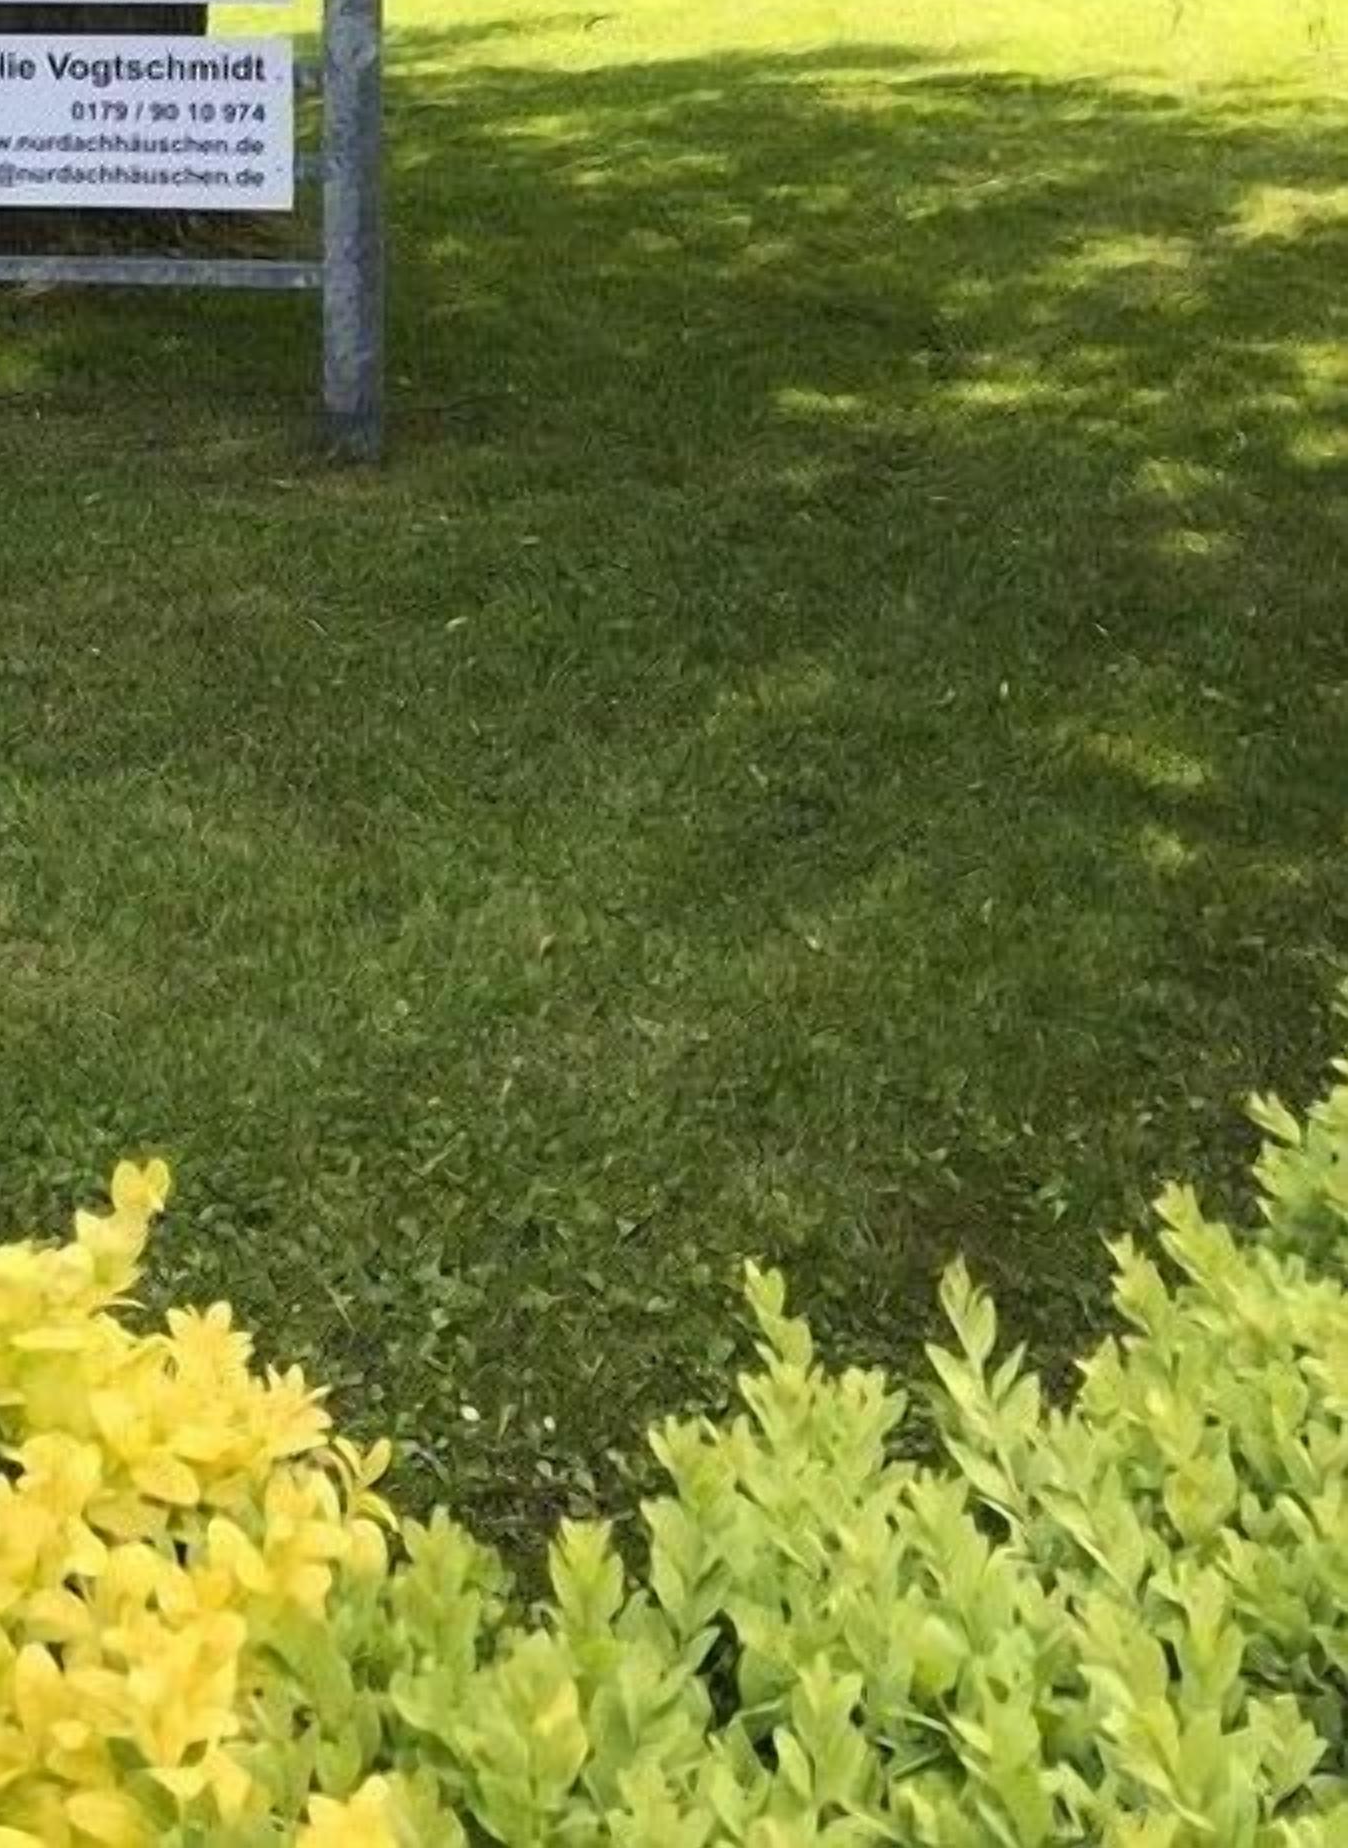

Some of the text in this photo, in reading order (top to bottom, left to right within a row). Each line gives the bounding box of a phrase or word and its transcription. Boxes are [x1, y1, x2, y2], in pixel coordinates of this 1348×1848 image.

[47, 51, 267, 89] Vogtschmidt
[70, 100, 129, 121] 0179
[188, 101, 217, 123] 10
